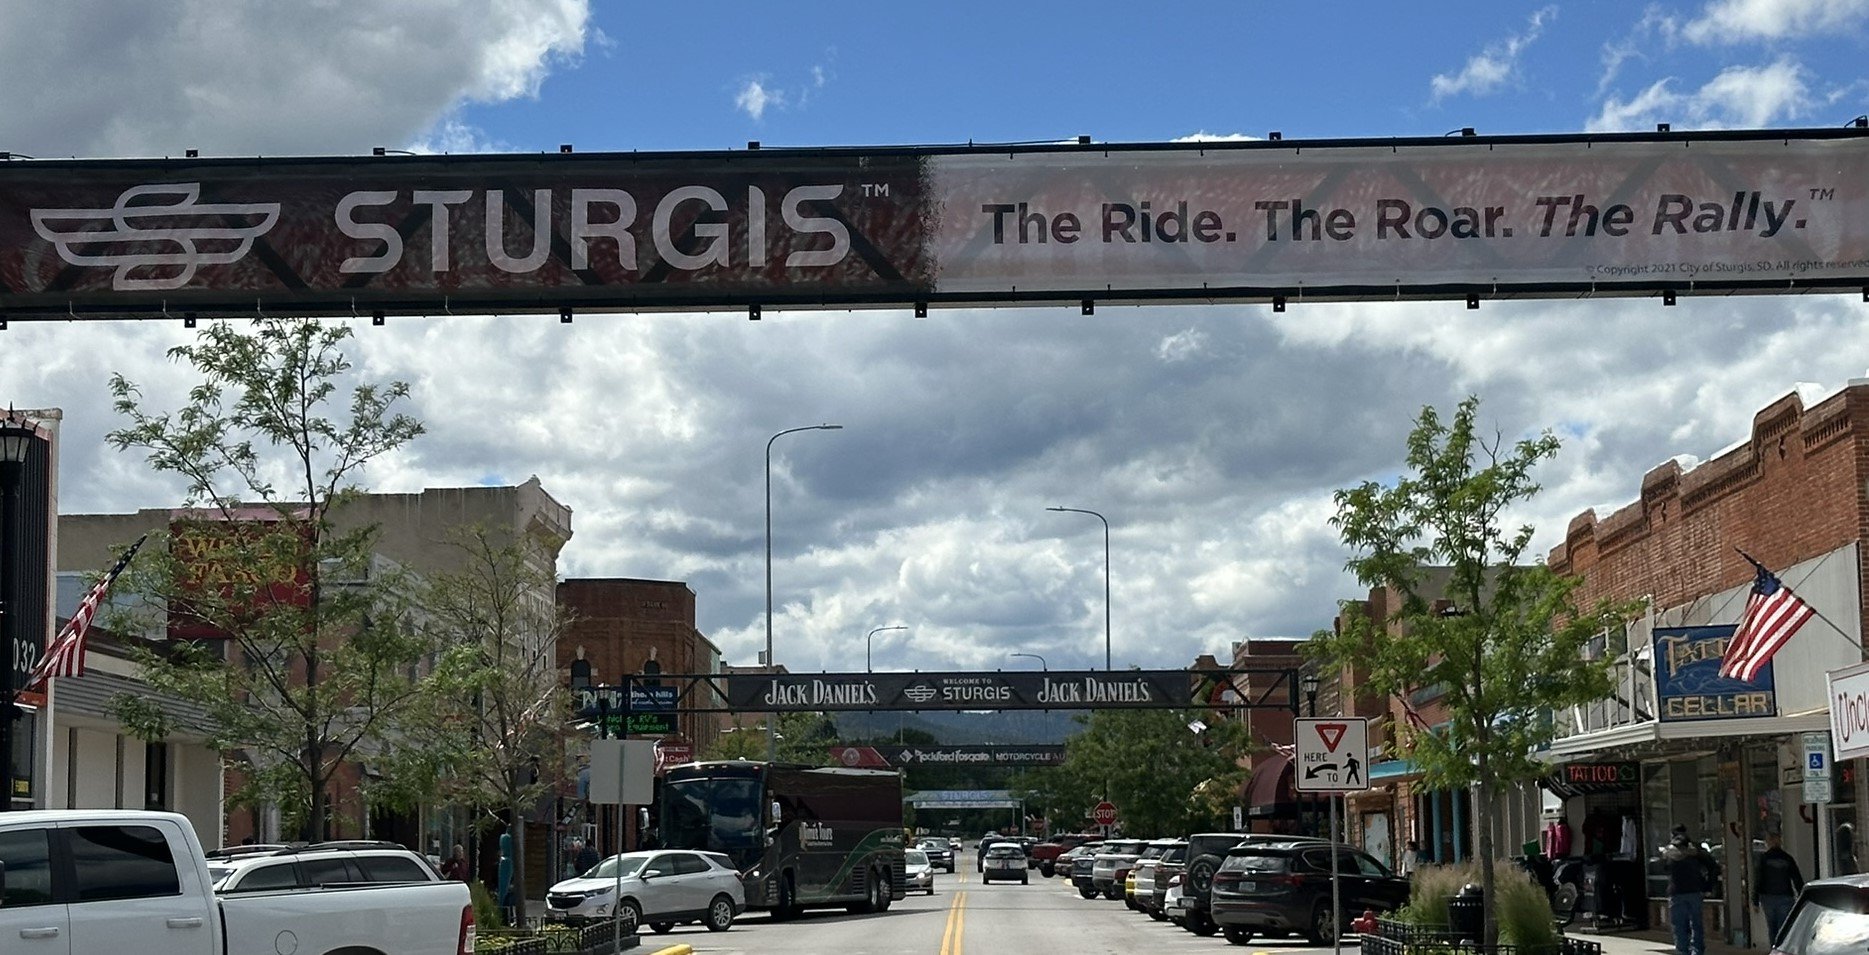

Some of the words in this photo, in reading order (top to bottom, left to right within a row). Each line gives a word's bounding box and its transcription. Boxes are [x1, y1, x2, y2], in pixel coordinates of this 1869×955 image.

[982, 201, 1083, 244] The
[1101, 200, 1237, 244] Ride.
[1255, 199, 1356, 242] The
[1376, 198, 1513, 240] Roar.
[1534, 193, 1633, 239] The
[1652, 188, 1808, 239] Rally.
[335, 184, 853, 274] STURGIS
[1597, 264, 1649, 276] Copyright
[1651, 263, 1676, 274] 2021
[1679, 262, 1700, 274] City
[1702, 261, 1714, 273] of
[1776, 260, 1790, 271] All
[1792, 260, 1825, 272] rights
[981, 677, 992, 685] TO
[765, 680, 808, 705] JACK
[813, 679, 877, 705] DANIEL'S
[942, 686, 1011, 700] STURGIS
[1037, 677, 1081, 703] JACK
[1085, 677, 1150, 702] DANIEL'S
[1667, 693, 1769, 718] CELLAR
[1838, 691, 1869, 743] Uncl
[914, 749, 955, 763] Rockford
[995, 752, 1051, 761] MOTORCYCLE
[1303, 752, 1328, 762] HERE
[1326, 772, 1339, 783] TO
[1095, 808, 1117, 819] STOP
